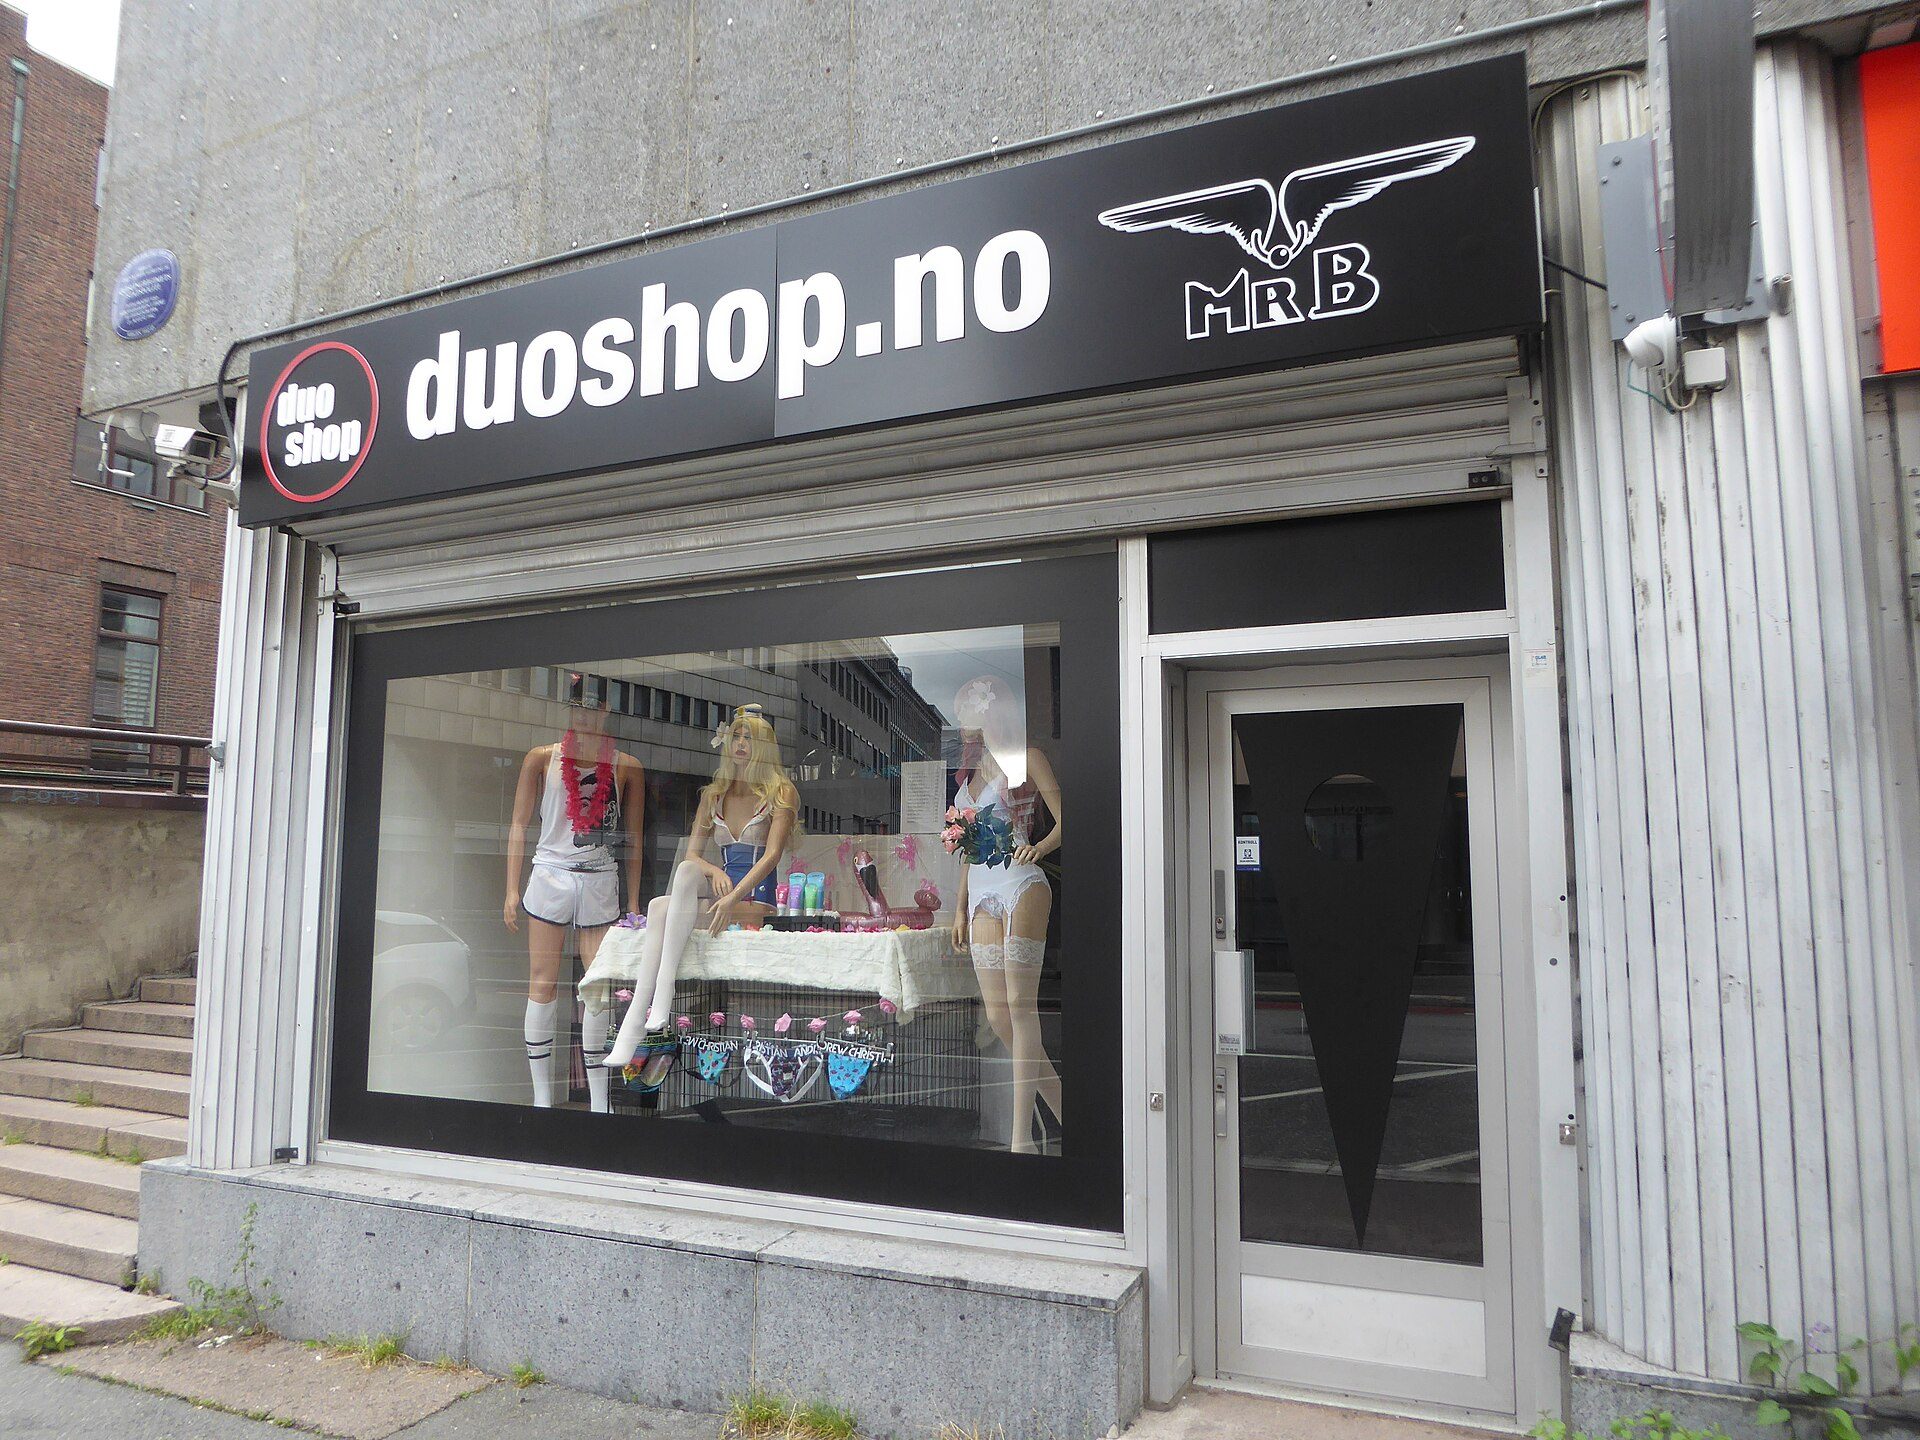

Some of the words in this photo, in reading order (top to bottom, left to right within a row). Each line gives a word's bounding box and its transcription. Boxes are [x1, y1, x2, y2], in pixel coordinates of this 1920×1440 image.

[405, 229, 1052, 441] duoshop.no
[276, 382, 336, 427] duo
[284, 419, 362, 468] shop
